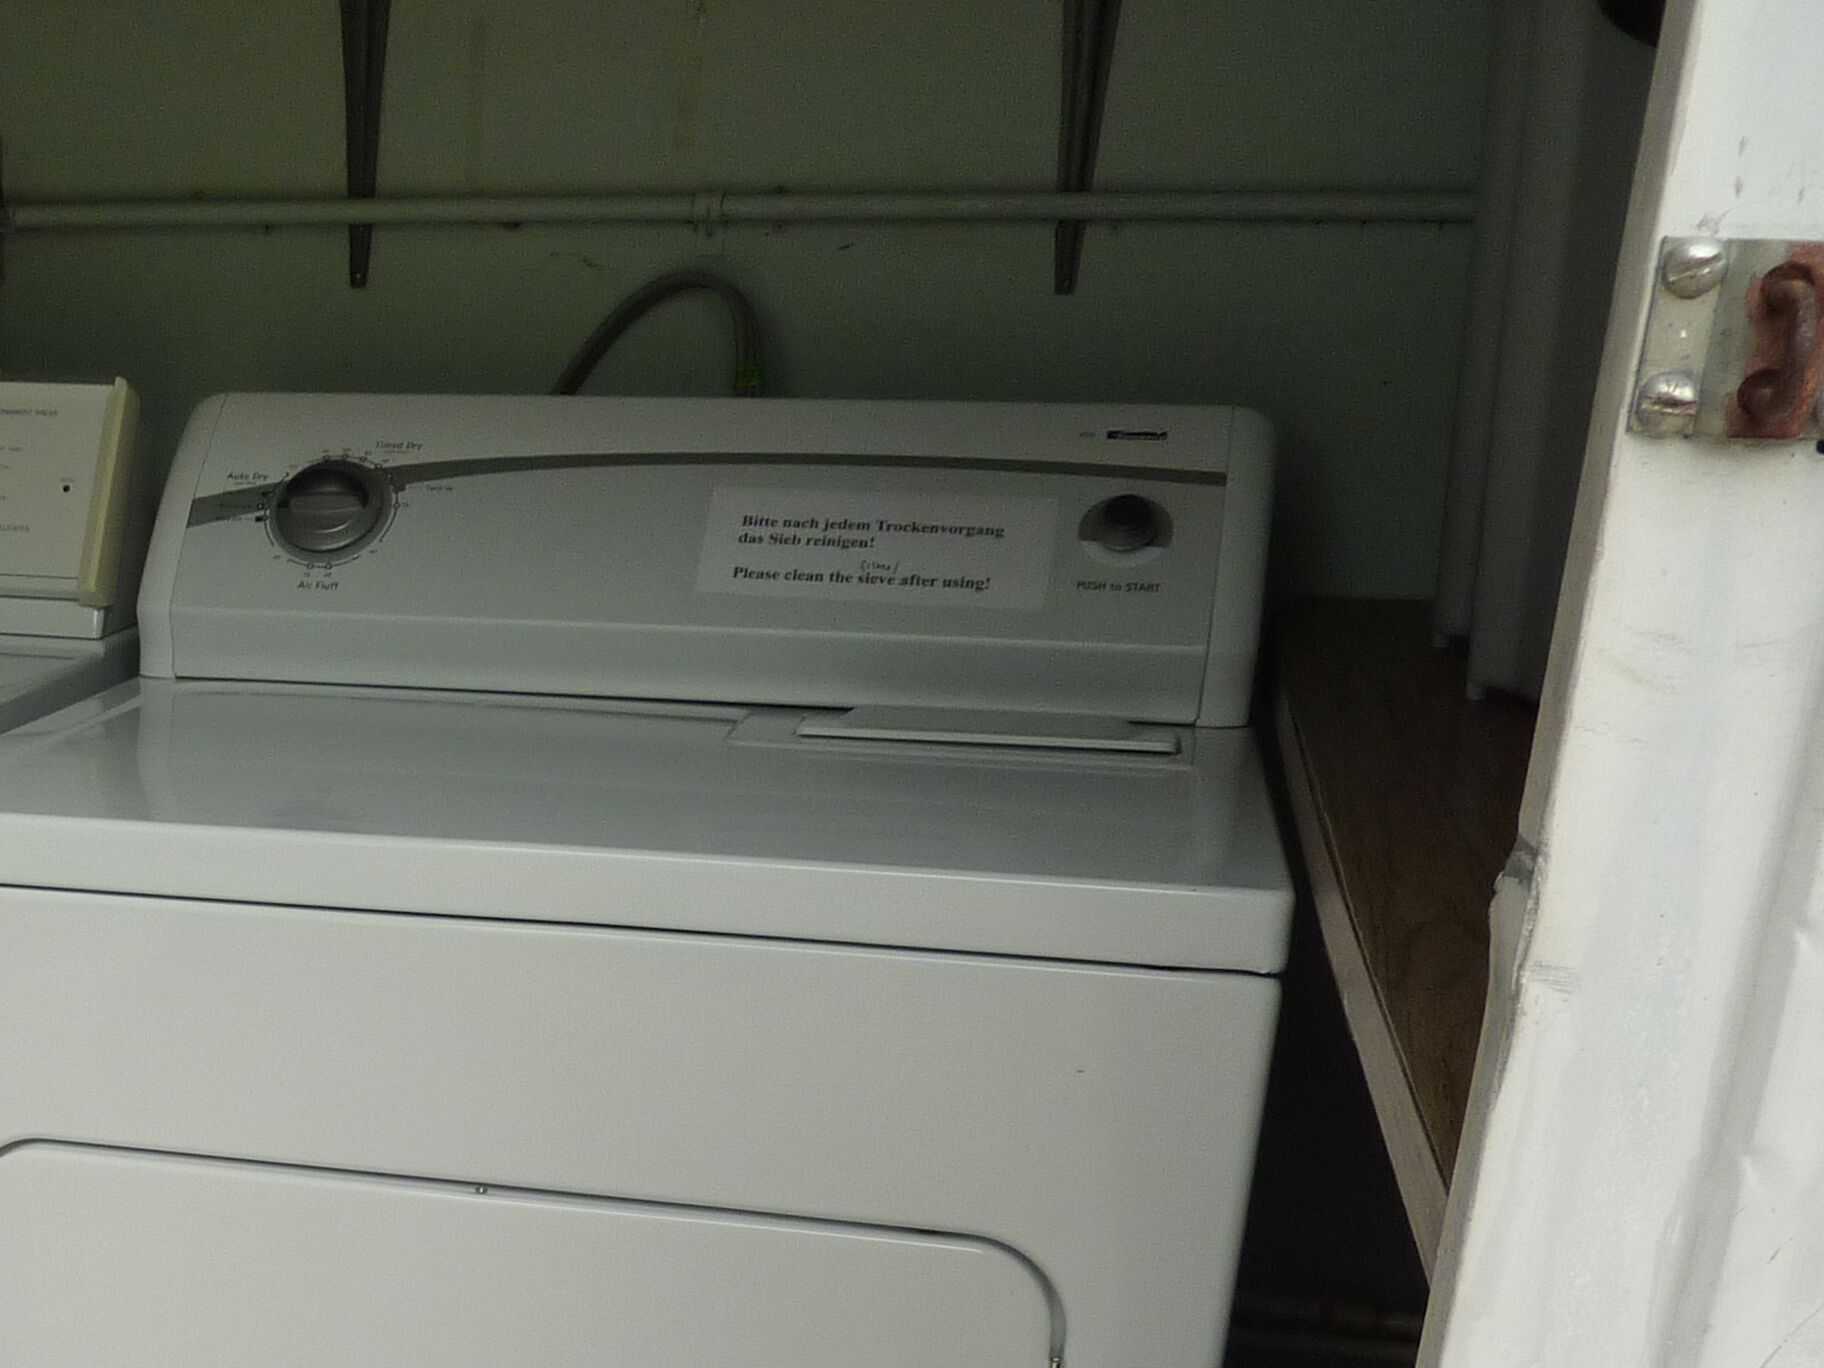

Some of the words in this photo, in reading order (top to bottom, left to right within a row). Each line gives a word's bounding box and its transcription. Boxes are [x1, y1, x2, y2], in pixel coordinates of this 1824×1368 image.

[406, 441, 424, 451] Dry
[226, 472, 250, 480] Auto
[252, 472, 269, 481] Dry
[742, 514, 779, 528] Bitte
[782, 516, 819, 529] nach
[823, 516, 871, 532] jedem
[875, 519, 1005, 538] Trockenvorgang
[738, 532, 764, 545] das
[768, 532, 801, 546] Sieb
[806, 534, 875, 549] reinigen!
[733, 566, 780, 580] Please
[784, 568, 823, 582] clean
[829, 570, 854, 584] the
[857, 572, 896, 586] sieve
[900, 573, 936, 588] after
[941, 576, 991, 592] using!
[1076, 580, 1107, 590] PUSH
[1110, 581, 1122, 591] to
[1125, 582, 1160, 592] START
